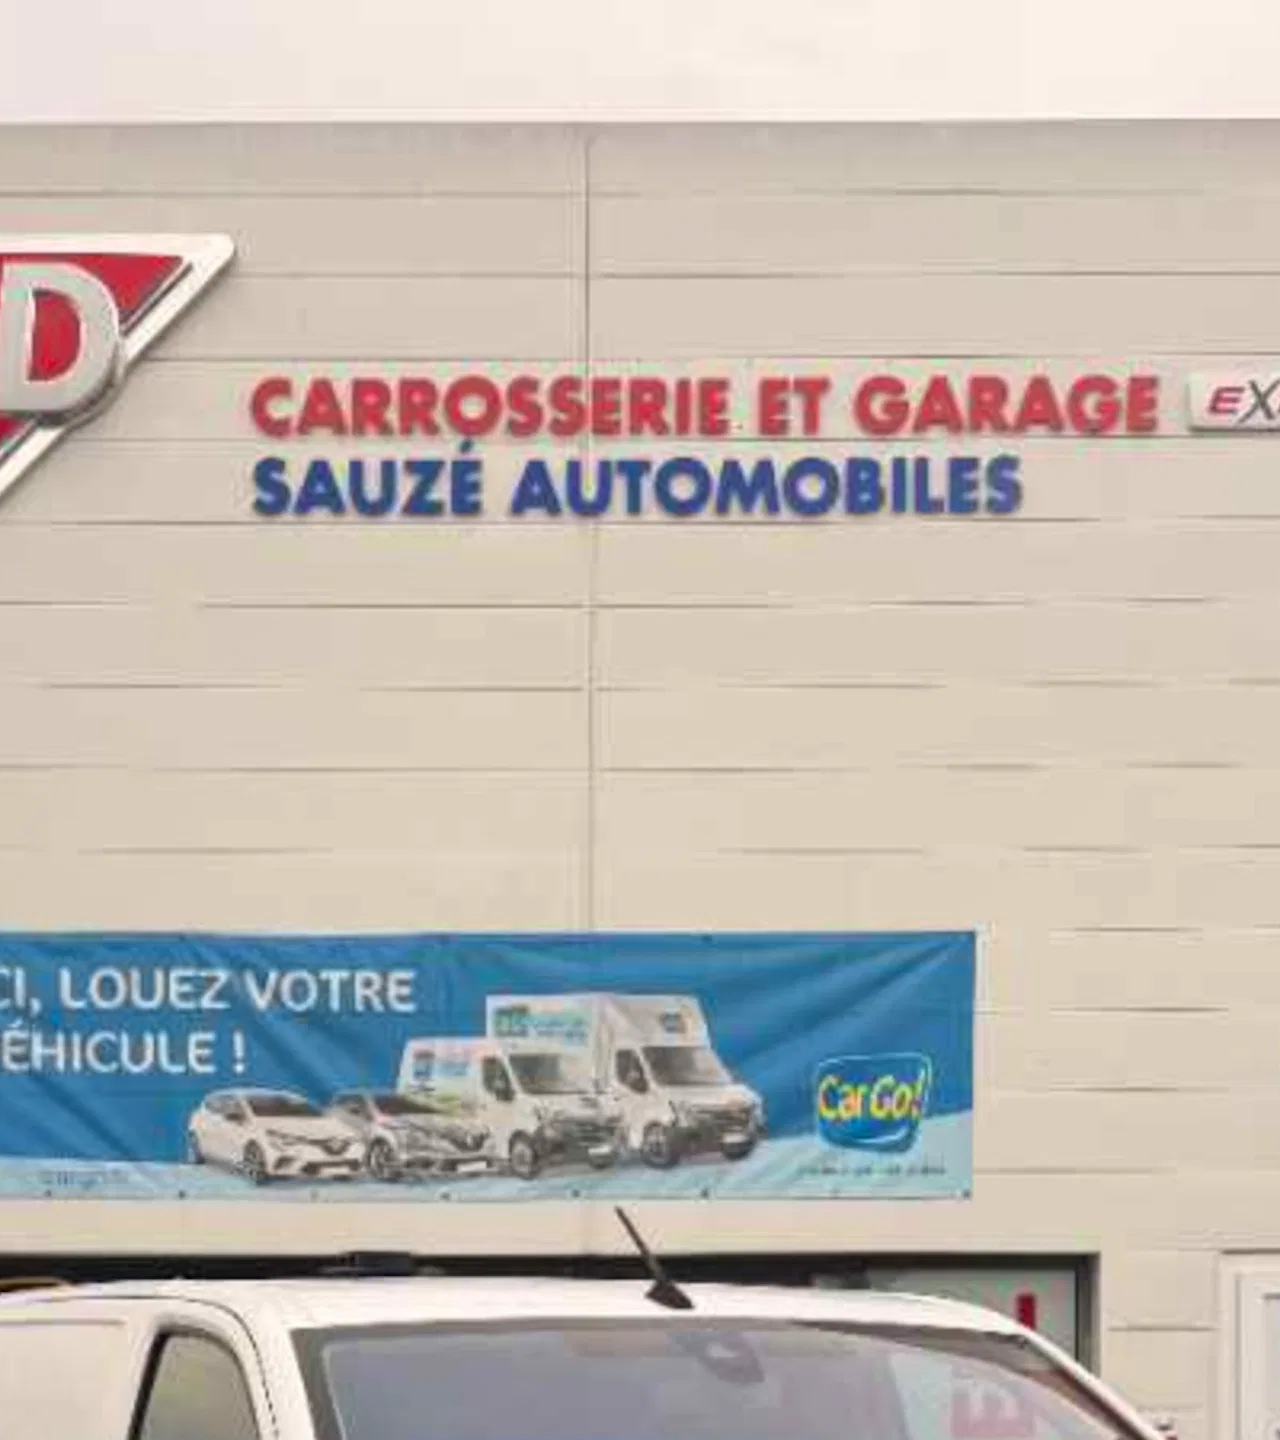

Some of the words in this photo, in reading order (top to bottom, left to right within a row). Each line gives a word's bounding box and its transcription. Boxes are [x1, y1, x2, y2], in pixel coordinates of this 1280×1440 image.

[250, 375, 732, 440] CARROSSERIE
[758, 375, 832, 438] ET
[853, 374, 1161, 436] GARAGE
[252, 437, 482, 517] SAUZÉ
[512, 455, 1023, 517] AUTOMOBILES
[58, 966, 232, 1012] LOUEZ
[243, 969, 418, 1014] VOTRE
[232, 1030, 246, 1074] !
